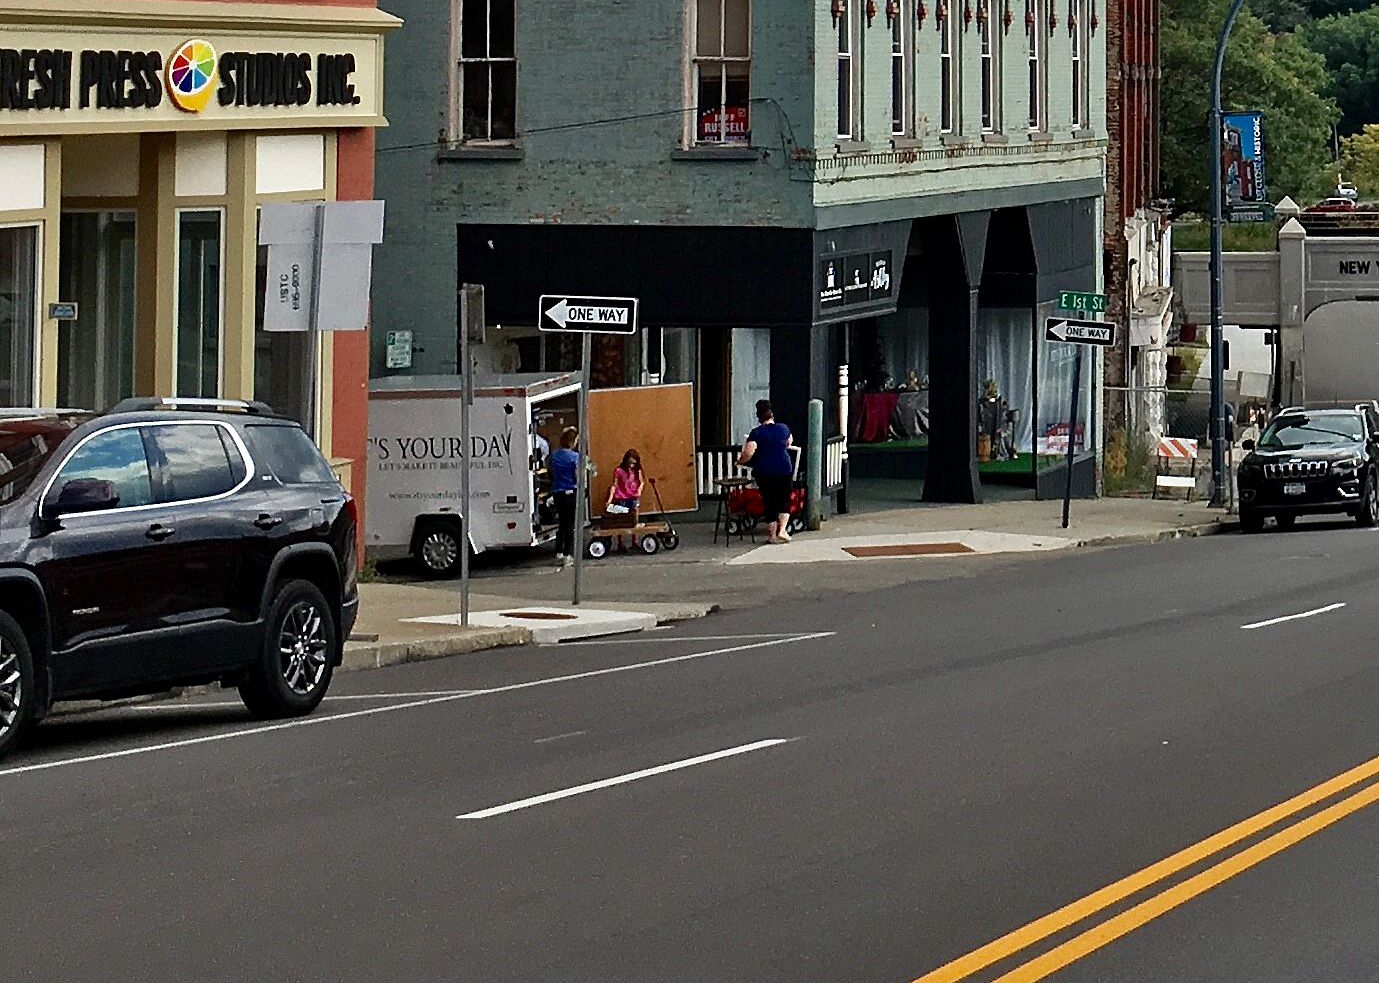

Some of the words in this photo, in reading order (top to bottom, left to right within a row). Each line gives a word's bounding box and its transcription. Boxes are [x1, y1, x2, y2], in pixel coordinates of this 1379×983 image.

[79, 50, 162, 109] PRESS
[217, 52, 312, 106] STUDIOS
[316, 53, 361, 106] INC.
[1339, 260, 1370, 275] NEW
[1061, 294, 1068, 308] E
[1093, 296, 1104, 310] St
[568, 307, 594, 321] ONE
[598, 308, 625, 322] WAY
[1066, 327, 1085, 336] ONE
[1088, 329, 1108, 339] WAY
[397, 437, 463, 460] YOUR
[471, 434, 512, 459] DAY
